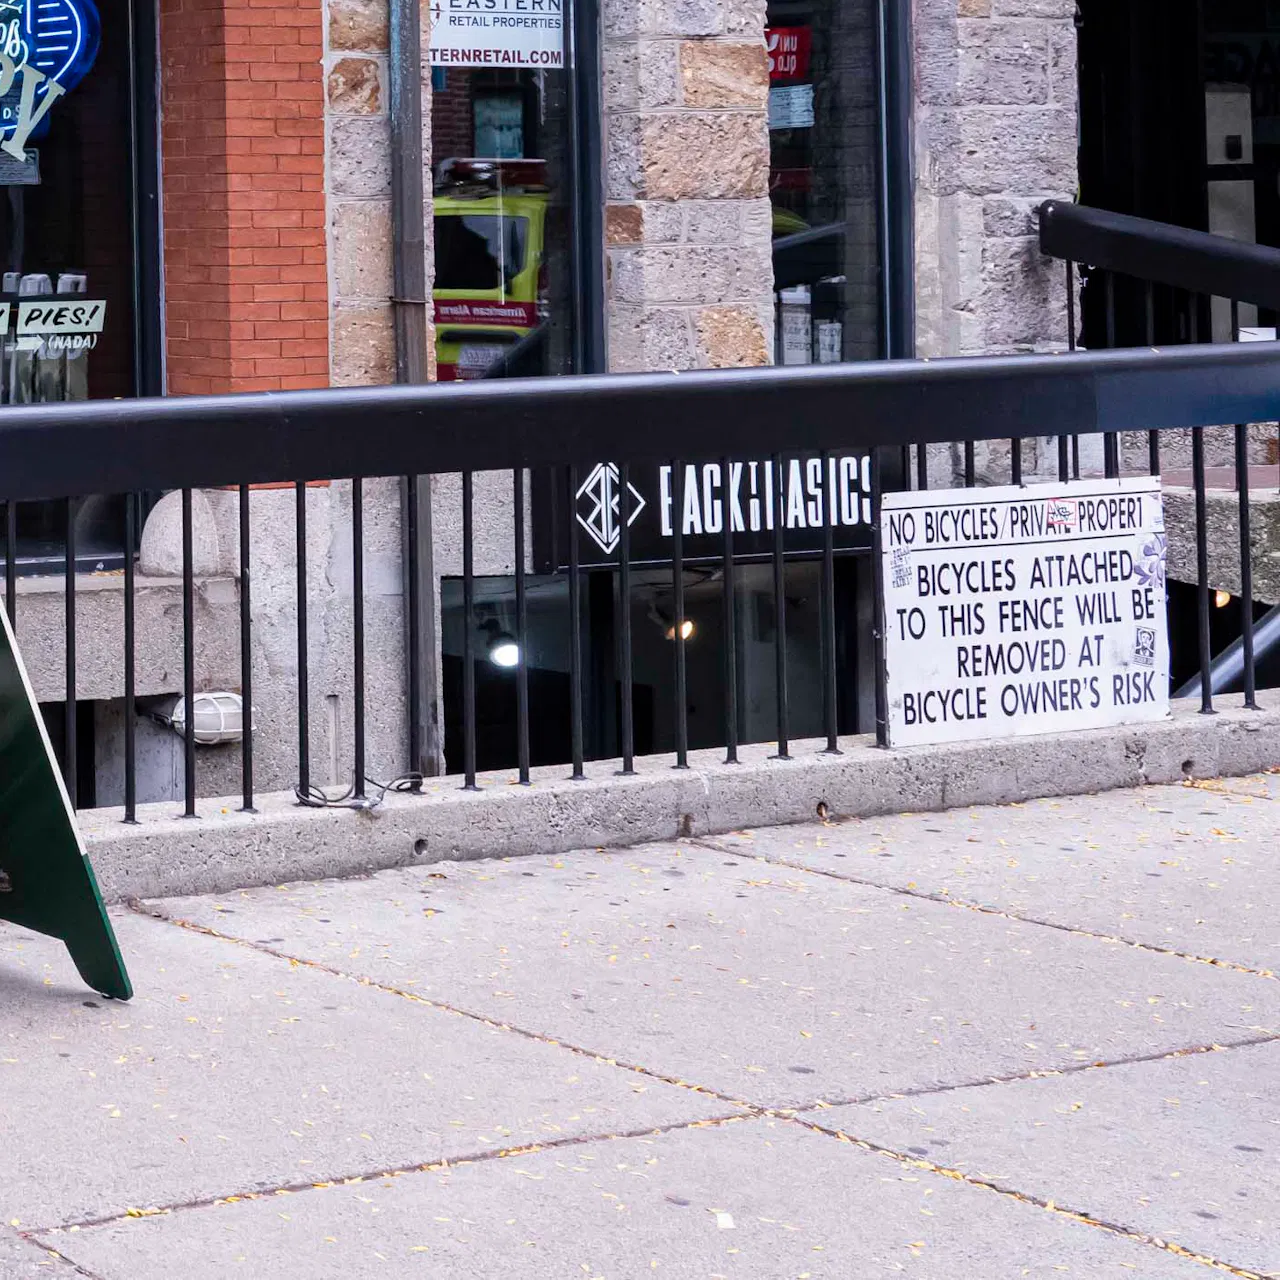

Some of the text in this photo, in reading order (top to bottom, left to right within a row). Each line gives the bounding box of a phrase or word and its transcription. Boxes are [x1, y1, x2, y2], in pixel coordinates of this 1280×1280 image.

[449, 16, 561, 29] RETAIL PROPERTIES
[24, 305, 100, 328] PIES!
[48, 333, 98, 350] (NADA)
[889, 511, 916, 546] NO
[918, 558, 1016, 598] BICYCLES
[1030, 549, 1133, 589] ATTACHED
[896, 587, 1155, 641] TO THIS FENCE WILL BE
[957, 634, 1105, 678] REMOVED AT
[903, 670, 1156, 725] BICYCLE OWNER'S RISK
